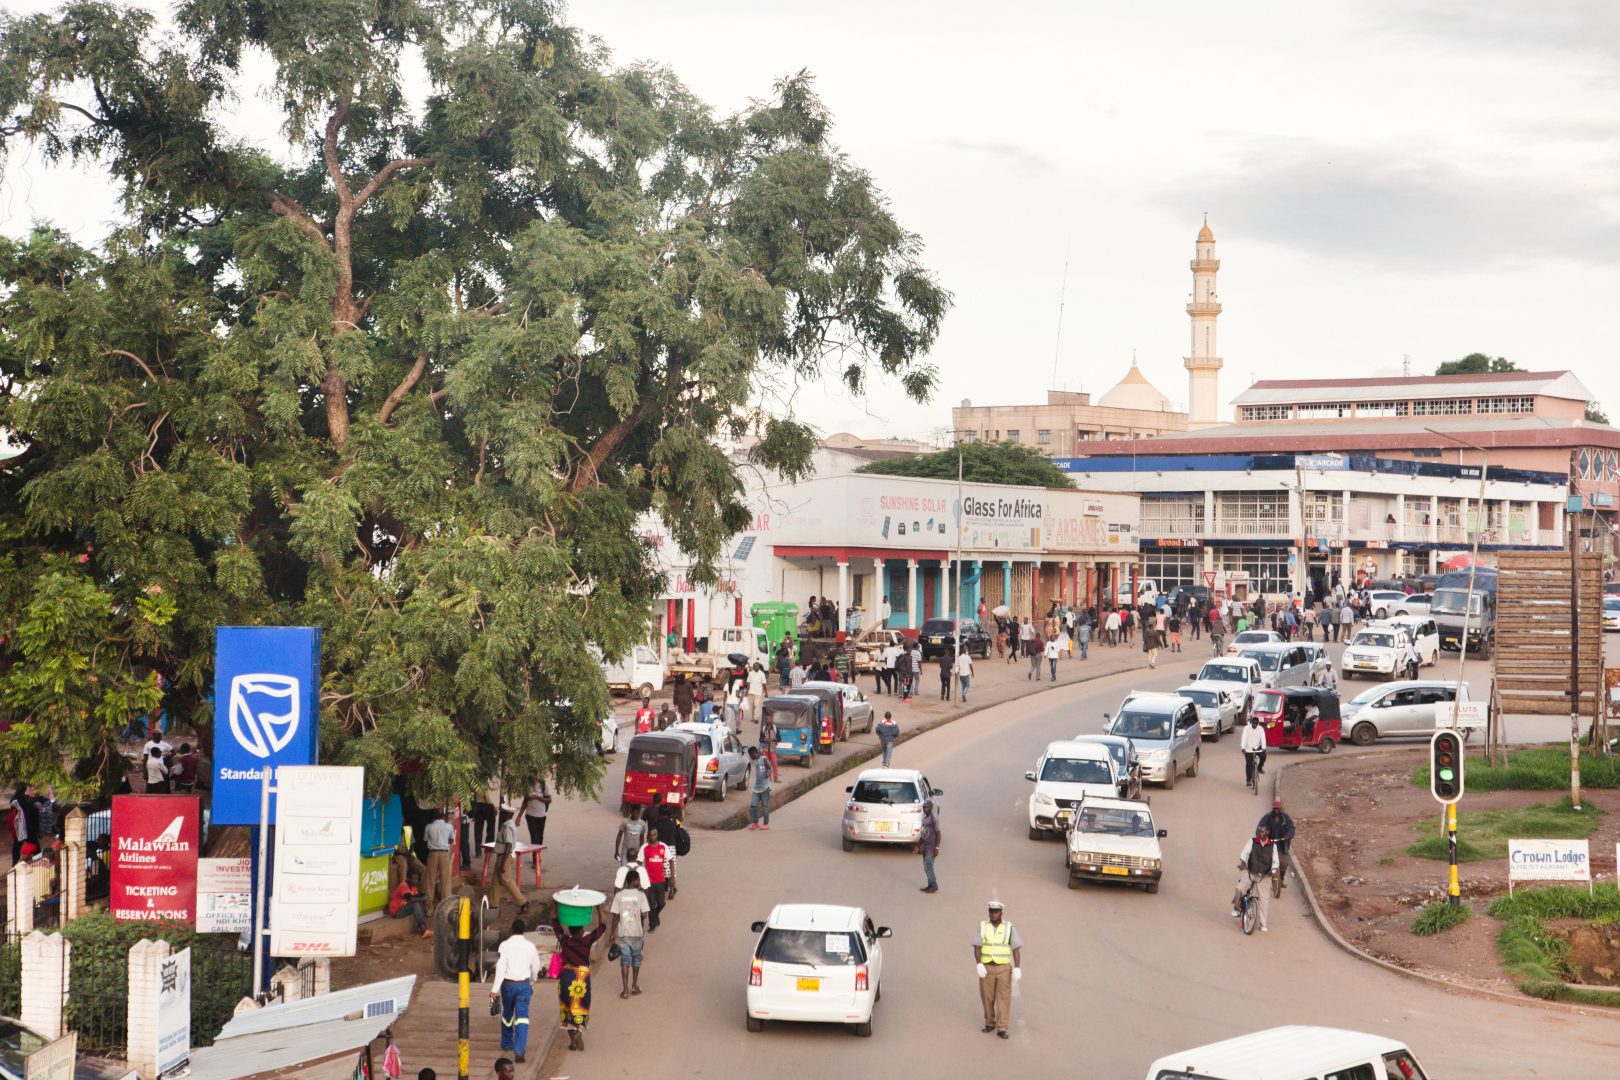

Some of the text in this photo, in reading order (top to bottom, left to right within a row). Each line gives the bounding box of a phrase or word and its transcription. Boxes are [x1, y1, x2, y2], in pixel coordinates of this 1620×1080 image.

[880, 496, 947, 513] SUNSHINE SOLAR
[964, 496, 1042, 518] Glass For Africa
[1183, 538, 1199, 547] Talk
[118, 837, 190, 851] Malawian
[118, 852, 156, 862] Airlines
[1512, 849, 1586, 867] Crown Lodge
[125, 886, 178, 896] TICKETING
[146, 898, 155, 908] &
[292, 942, 332, 951] DHL
